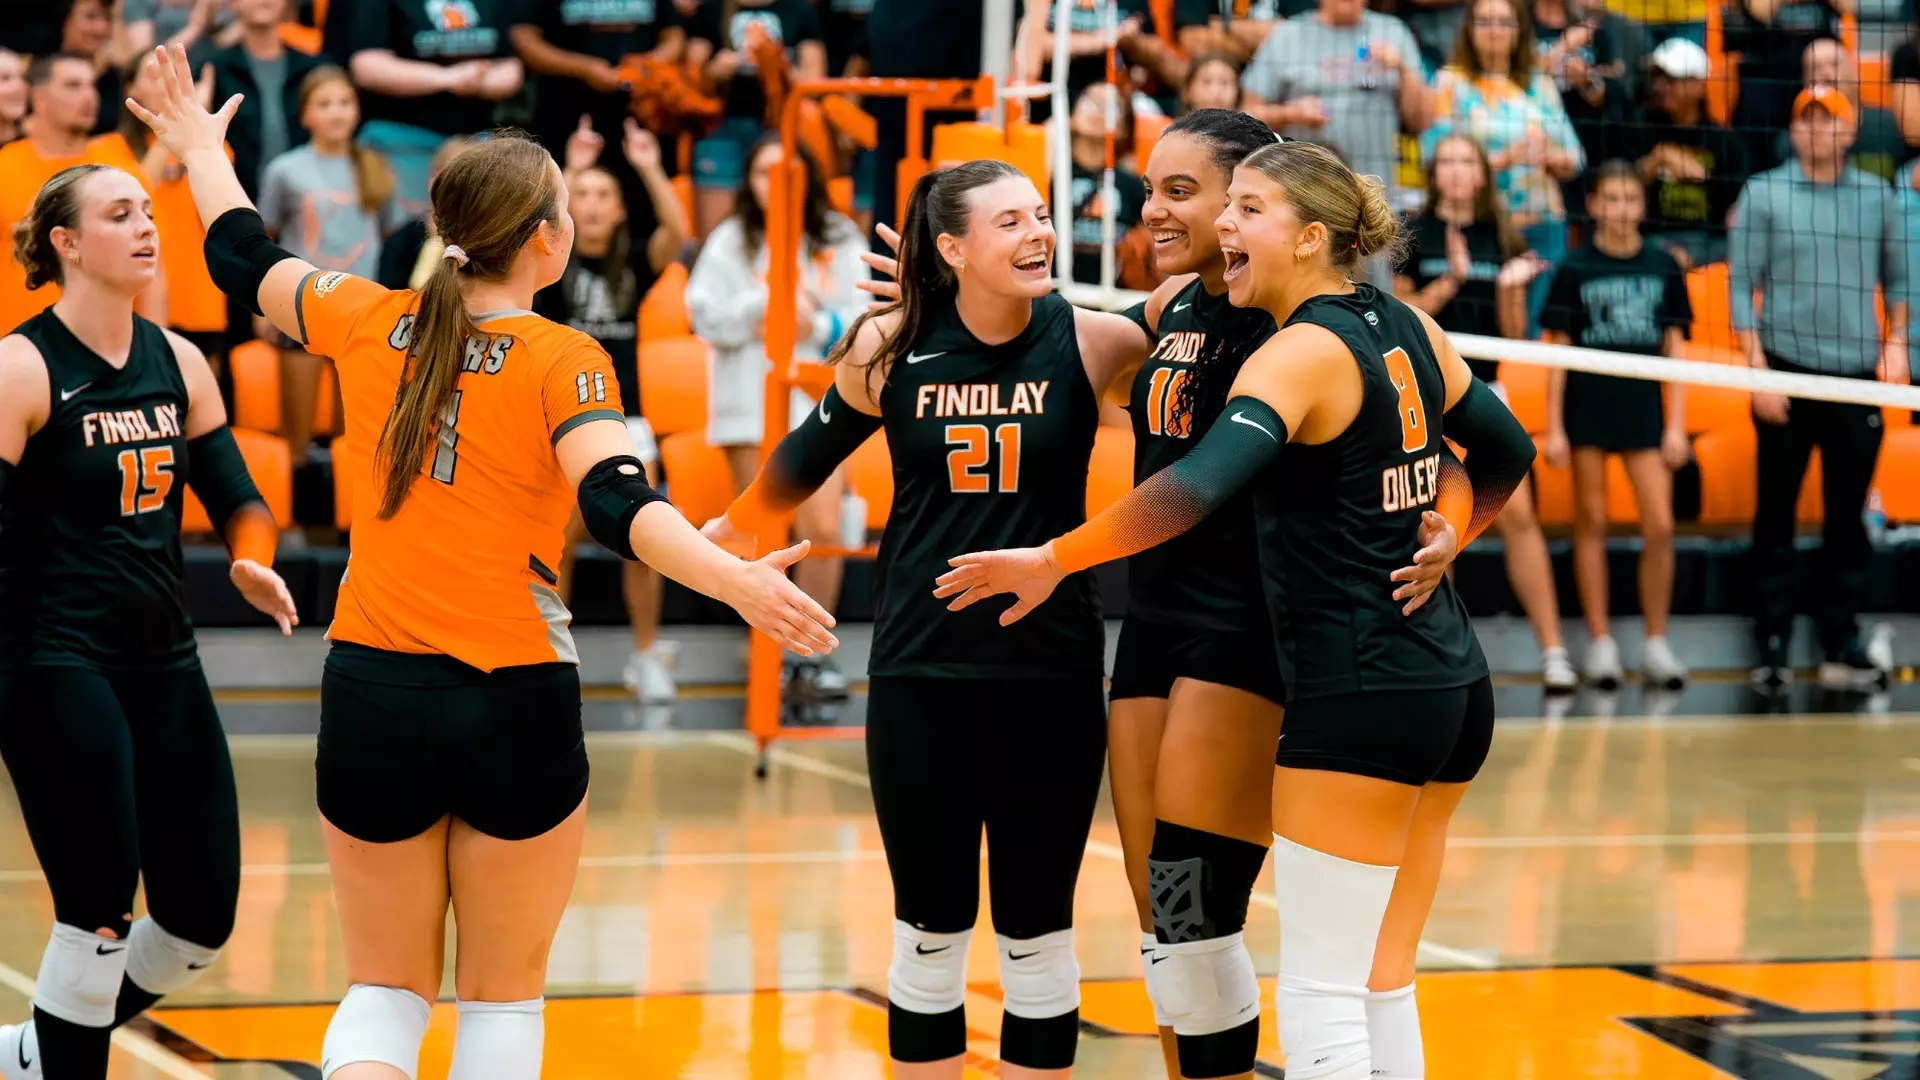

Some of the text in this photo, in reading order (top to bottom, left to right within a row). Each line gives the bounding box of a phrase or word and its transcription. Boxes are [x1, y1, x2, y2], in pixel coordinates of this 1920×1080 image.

[575, 371, 606, 405] 11
[915, 380, 1050, 419] FINDLAY
[1382, 345, 1428, 453] 8
[82, 403, 181, 448] FINDLAY
[117, 445, 175, 517] 15
[945, 422, 1022, 493] 21
[1382, 453, 1440, 513] OILER
